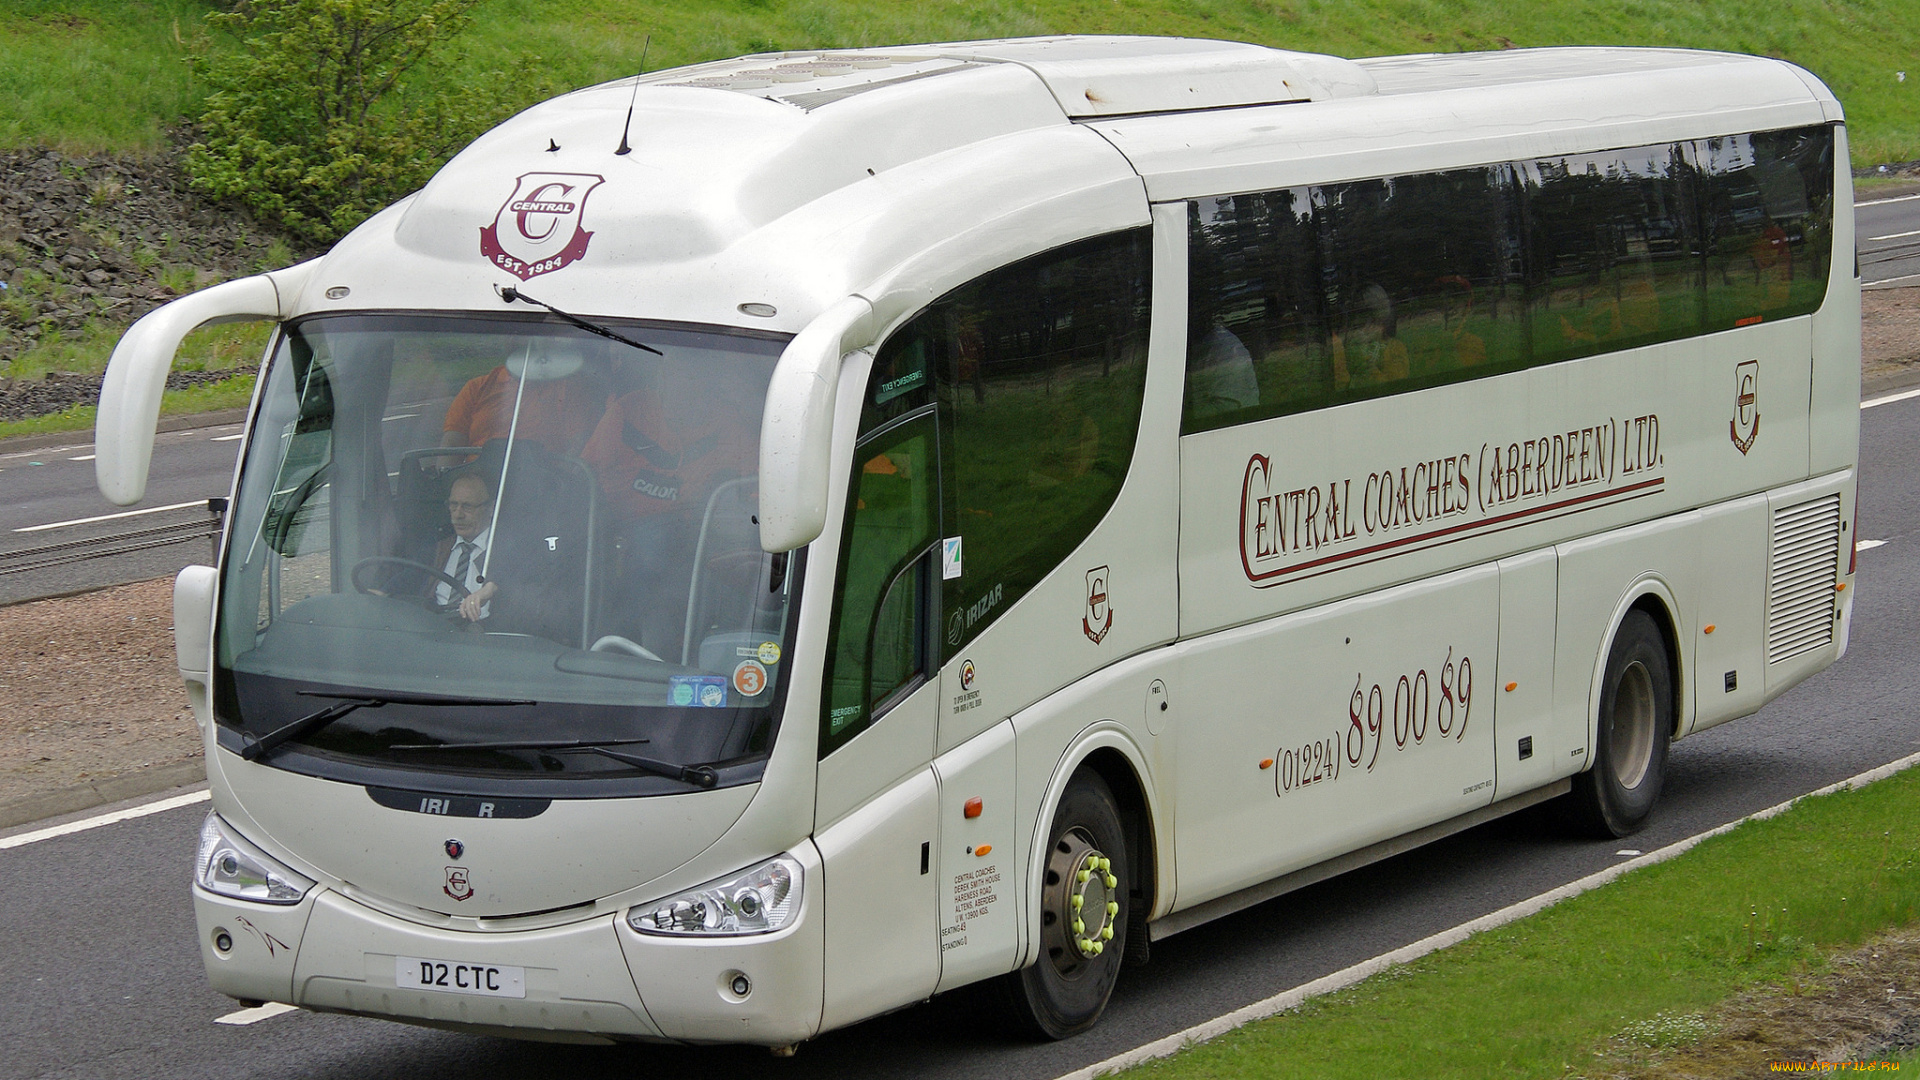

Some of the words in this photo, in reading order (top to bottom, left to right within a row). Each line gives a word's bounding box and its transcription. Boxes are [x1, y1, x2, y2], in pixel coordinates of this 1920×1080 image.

[512, 202, 572, 213] CENTRAL
[496, 254, 523, 275] EST.
[527, 256, 562, 276] 1984
[1240, 453, 1356, 580] CENTRAL
[1363, 453, 1471, 536] COACHES
[1477, 417, 1616, 515] (ABERDEEN)
[1622, 413, 1664, 476] LTD.
[966, 583, 1003, 629] IRIZAR
[742, 672, 759, 692] 3
[1275, 730, 1340, 798] (01224)
[1394, 669, 1429, 751] 00
[954, 872, 974, 884] CENTRAL
[975, 865, 996, 877] COACHES
[954, 883, 969, 894] DEREK
[970, 878, 984, 889] SMITH
[985, 873, 1001, 884] HOUSE
[954, 890, 978, 903] HARENESS
[980, 885, 992, 895] ROAD
[975, 894, 997, 907] ABERDEEN
[941, 924, 960, 937] SEATING
[942, 938, 964, 952] STANDING
[420, 962, 448, 986] D2
[455, 965, 500, 991] CTC
